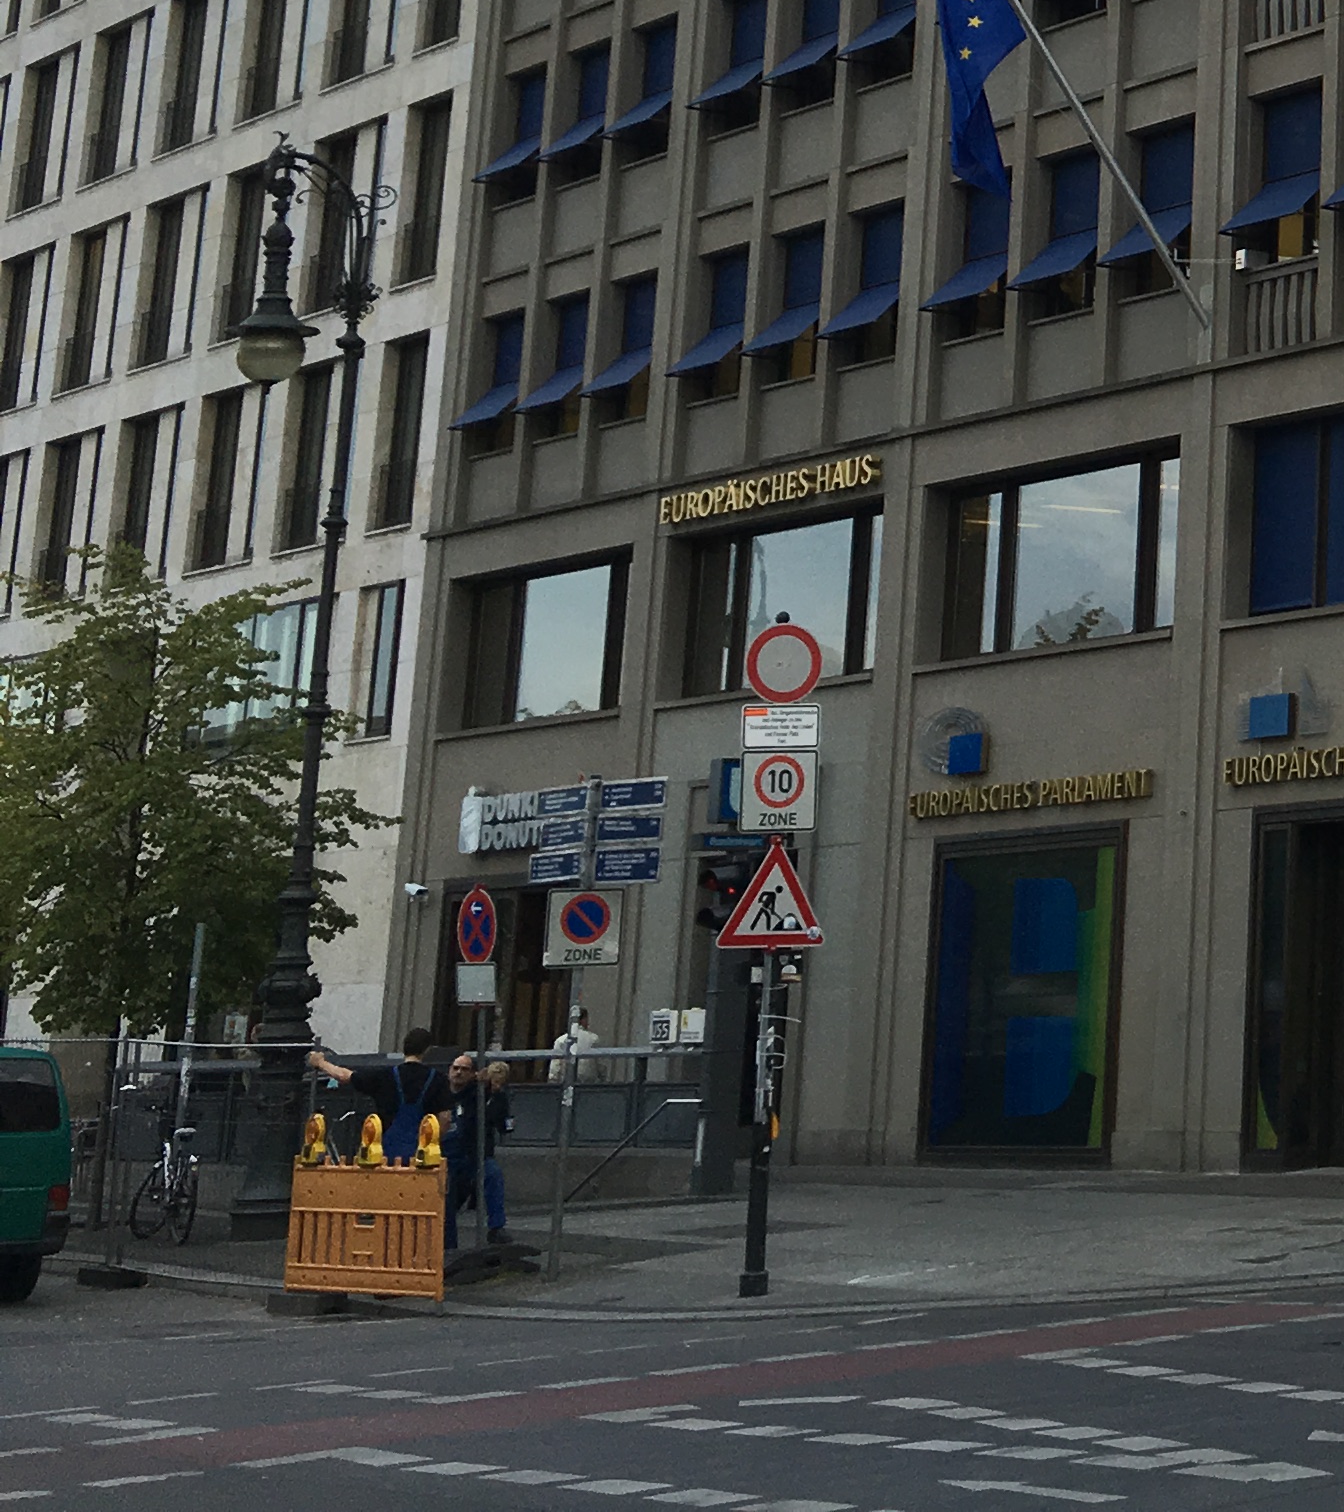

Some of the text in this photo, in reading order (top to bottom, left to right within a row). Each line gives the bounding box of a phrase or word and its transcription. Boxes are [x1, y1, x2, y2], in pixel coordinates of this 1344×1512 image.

[659, 454, 873, 525] EUROPÄISCHES HAUS
[768, 769, 793, 794] 10
[908, 769, 1150, 818] EUROPÄISCHES PARLAMENT
[759, 812, 798, 826] ZONE
[480, 820, 543, 851] DONUT
[564, 948, 603, 962] ZONE
